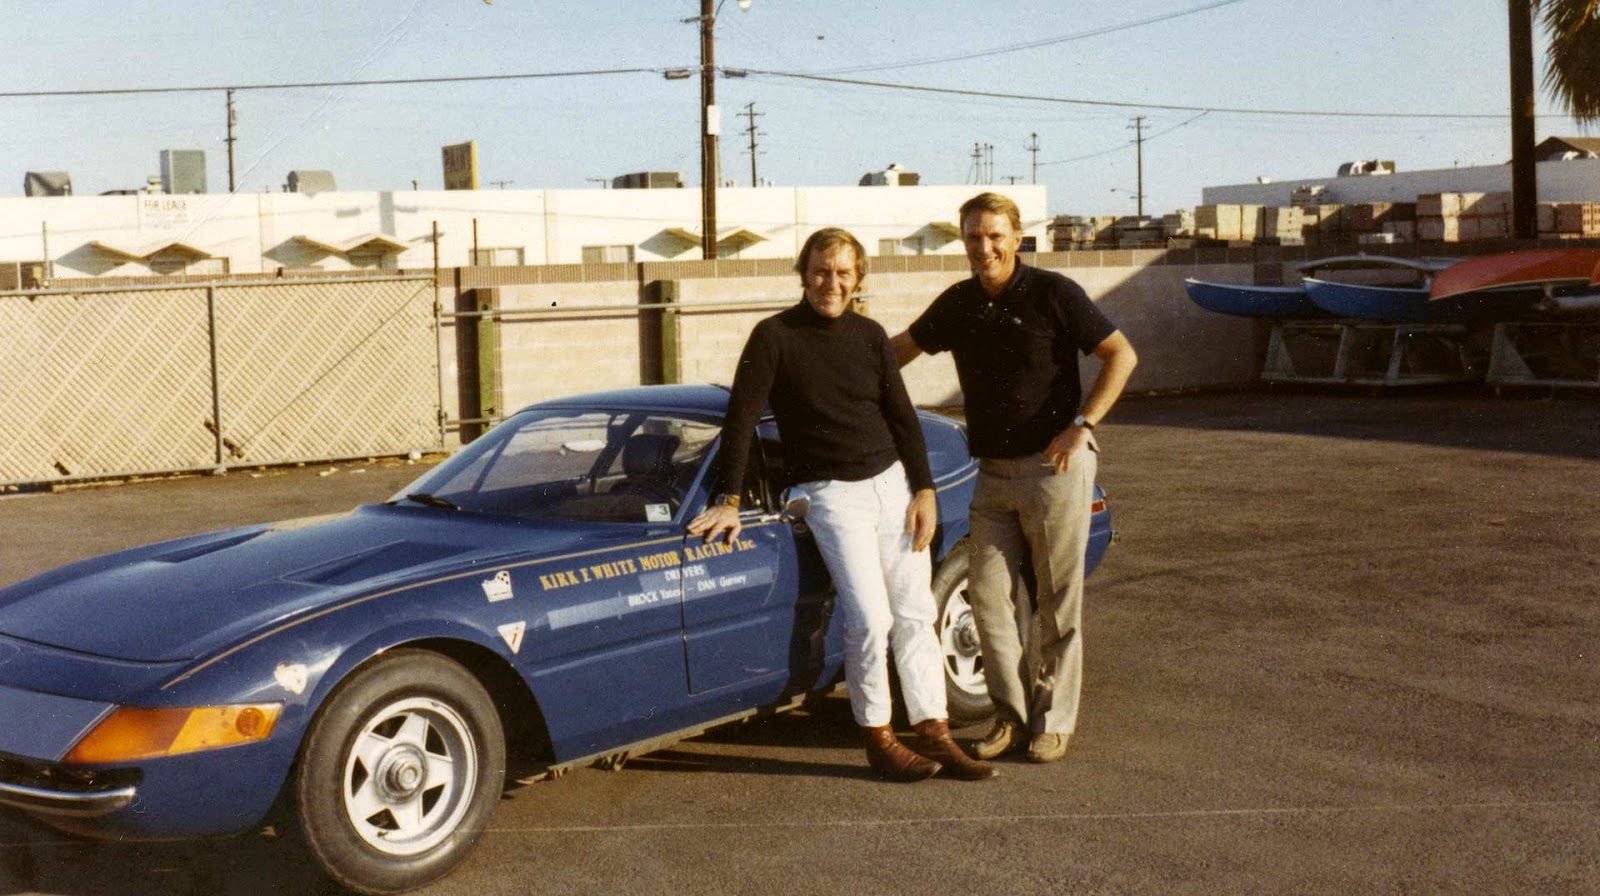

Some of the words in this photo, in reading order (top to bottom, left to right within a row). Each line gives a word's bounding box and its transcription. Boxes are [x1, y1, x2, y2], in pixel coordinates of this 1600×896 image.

[539, 570, 580, 591] KIRK
[590, 559, 637, 581] WHITE
[638, 550, 682, 572] MOTOR
[627, 591, 659, 607] BROCK
[697, 578, 717, 592] DAN
[719, 574, 747, 588] Gurney
